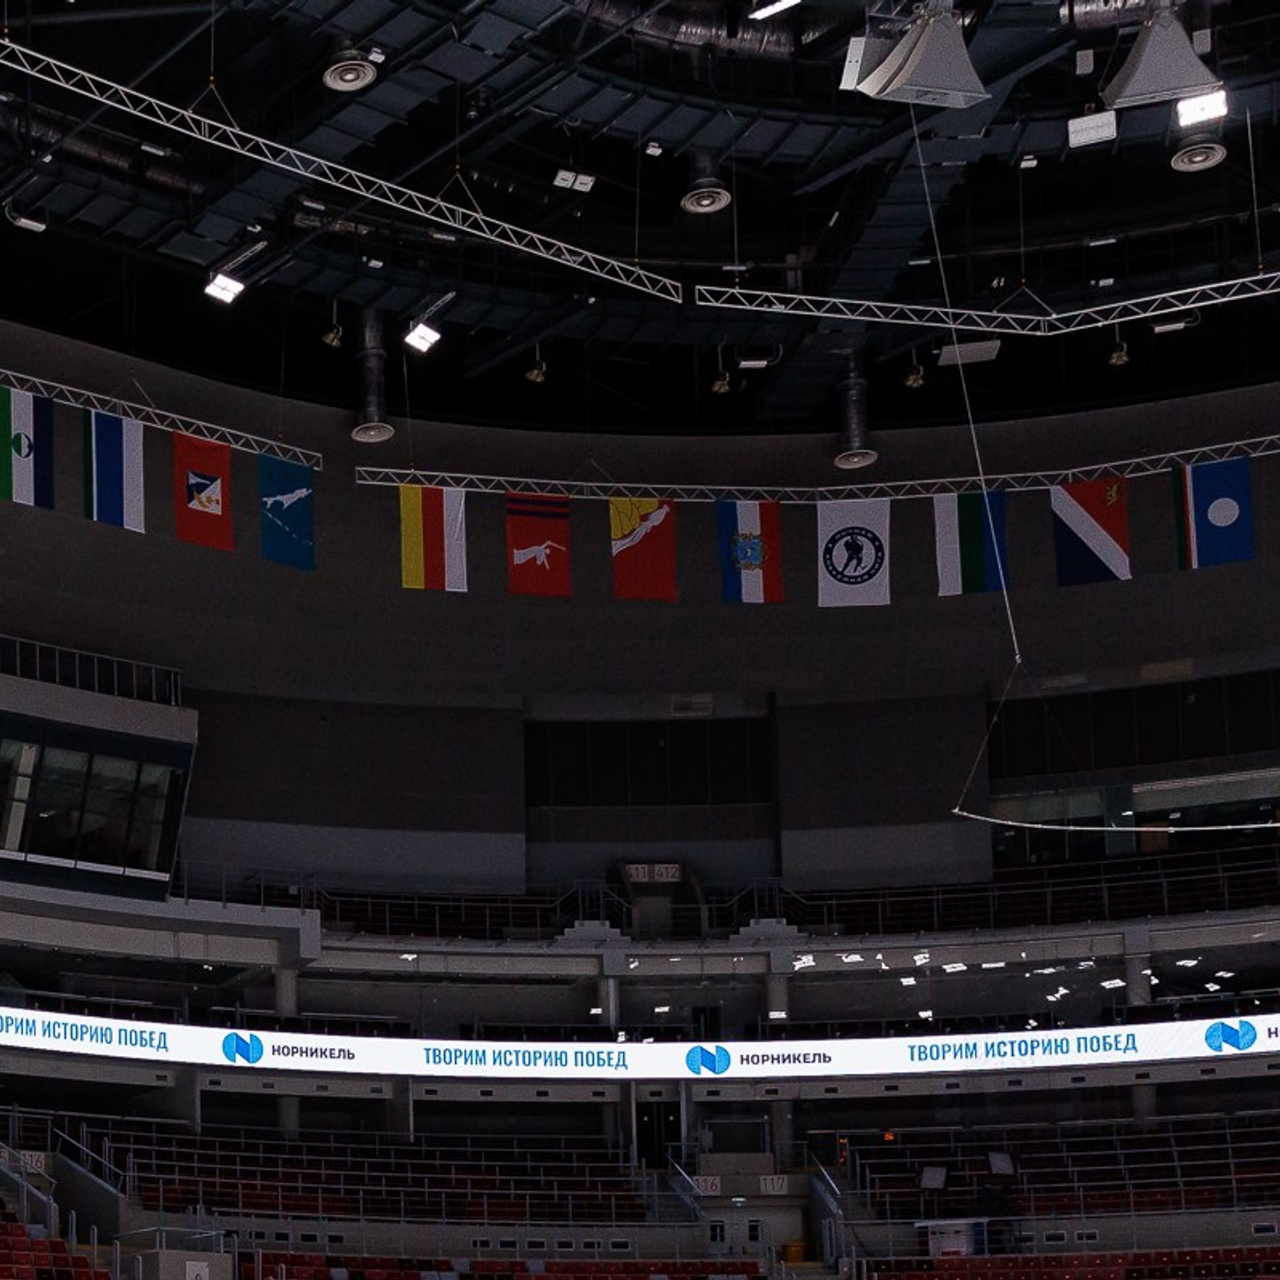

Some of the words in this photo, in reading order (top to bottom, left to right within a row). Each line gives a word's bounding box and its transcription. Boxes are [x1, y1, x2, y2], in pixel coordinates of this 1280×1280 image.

[42, 1020, 113, 1045] ИСТОРИЮ
[118, 1029, 169, 1052] ПОБЕД
[271, 1045, 355, 1060] НОРНИКЕЛЬ
[908, 1042, 978, 1061] ТВОРИМ
[984, 1037, 1070, 1058] ИСТОРИЮ
[1076, 1034, 1138, 1053] ПОБЕД
[424, 1048, 486, 1066] ТВОРИМ
[492, 1050, 568, 1067] ИСТОРИЮ
[574, 1051, 628, 1070] ПОБЕД
[740, 1053, 832, 1066] НОРНИКЕЛЬ
